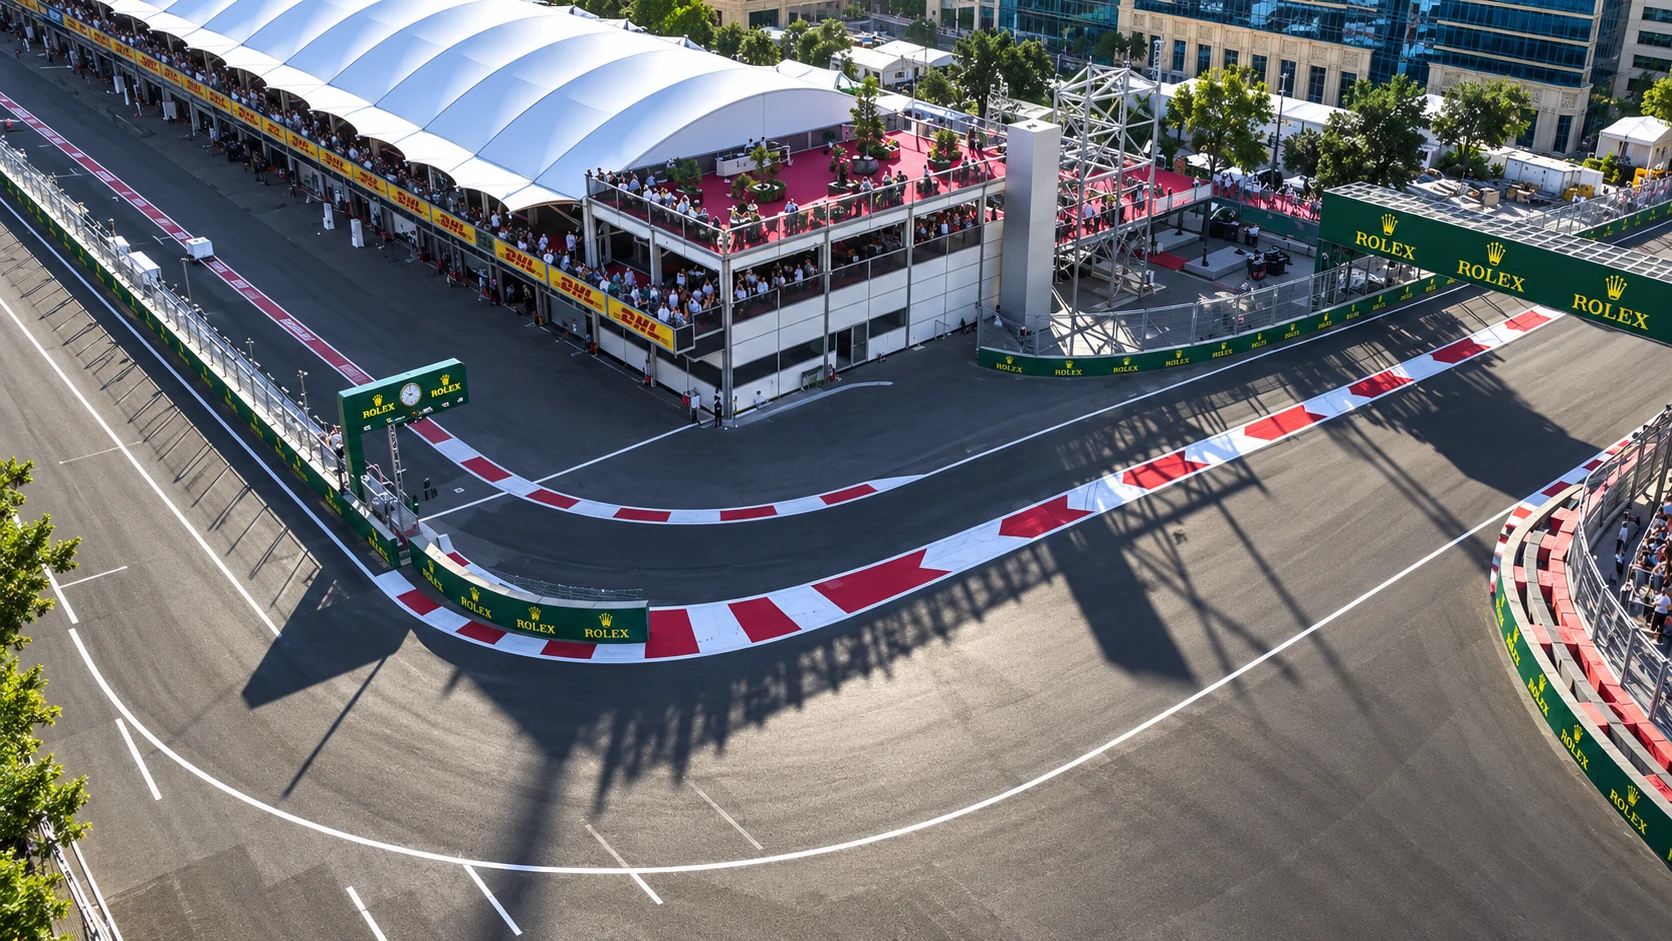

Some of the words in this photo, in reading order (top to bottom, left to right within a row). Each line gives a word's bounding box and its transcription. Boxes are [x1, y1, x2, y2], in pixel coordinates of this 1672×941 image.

[440, 213, 467, 238] DHL
[1355, 230, 1416, 261] ROLEX
[505, 247, 538, 275] DHL
[561, 276, 595, 305] DHL
[1457, 259, 1525, 293] ROLEX
[621, 305, 661, 341] DHL
[1572, 293, 1650, 330] ROLEX
[431, 382, 462, 398] ROLEX
[362, 402, 395, 419] ROLEX
[461, 595, 492, 619] ROLEX
[516, 618, 556, 635] ROLEX
[584, 628, 629, 638] ROLEX
[1527, 677, 1549, 717] ROLEX
[1560, 728, 1589, 771] ROLEX
[1609, 788, 1648, 835] ROLEX
